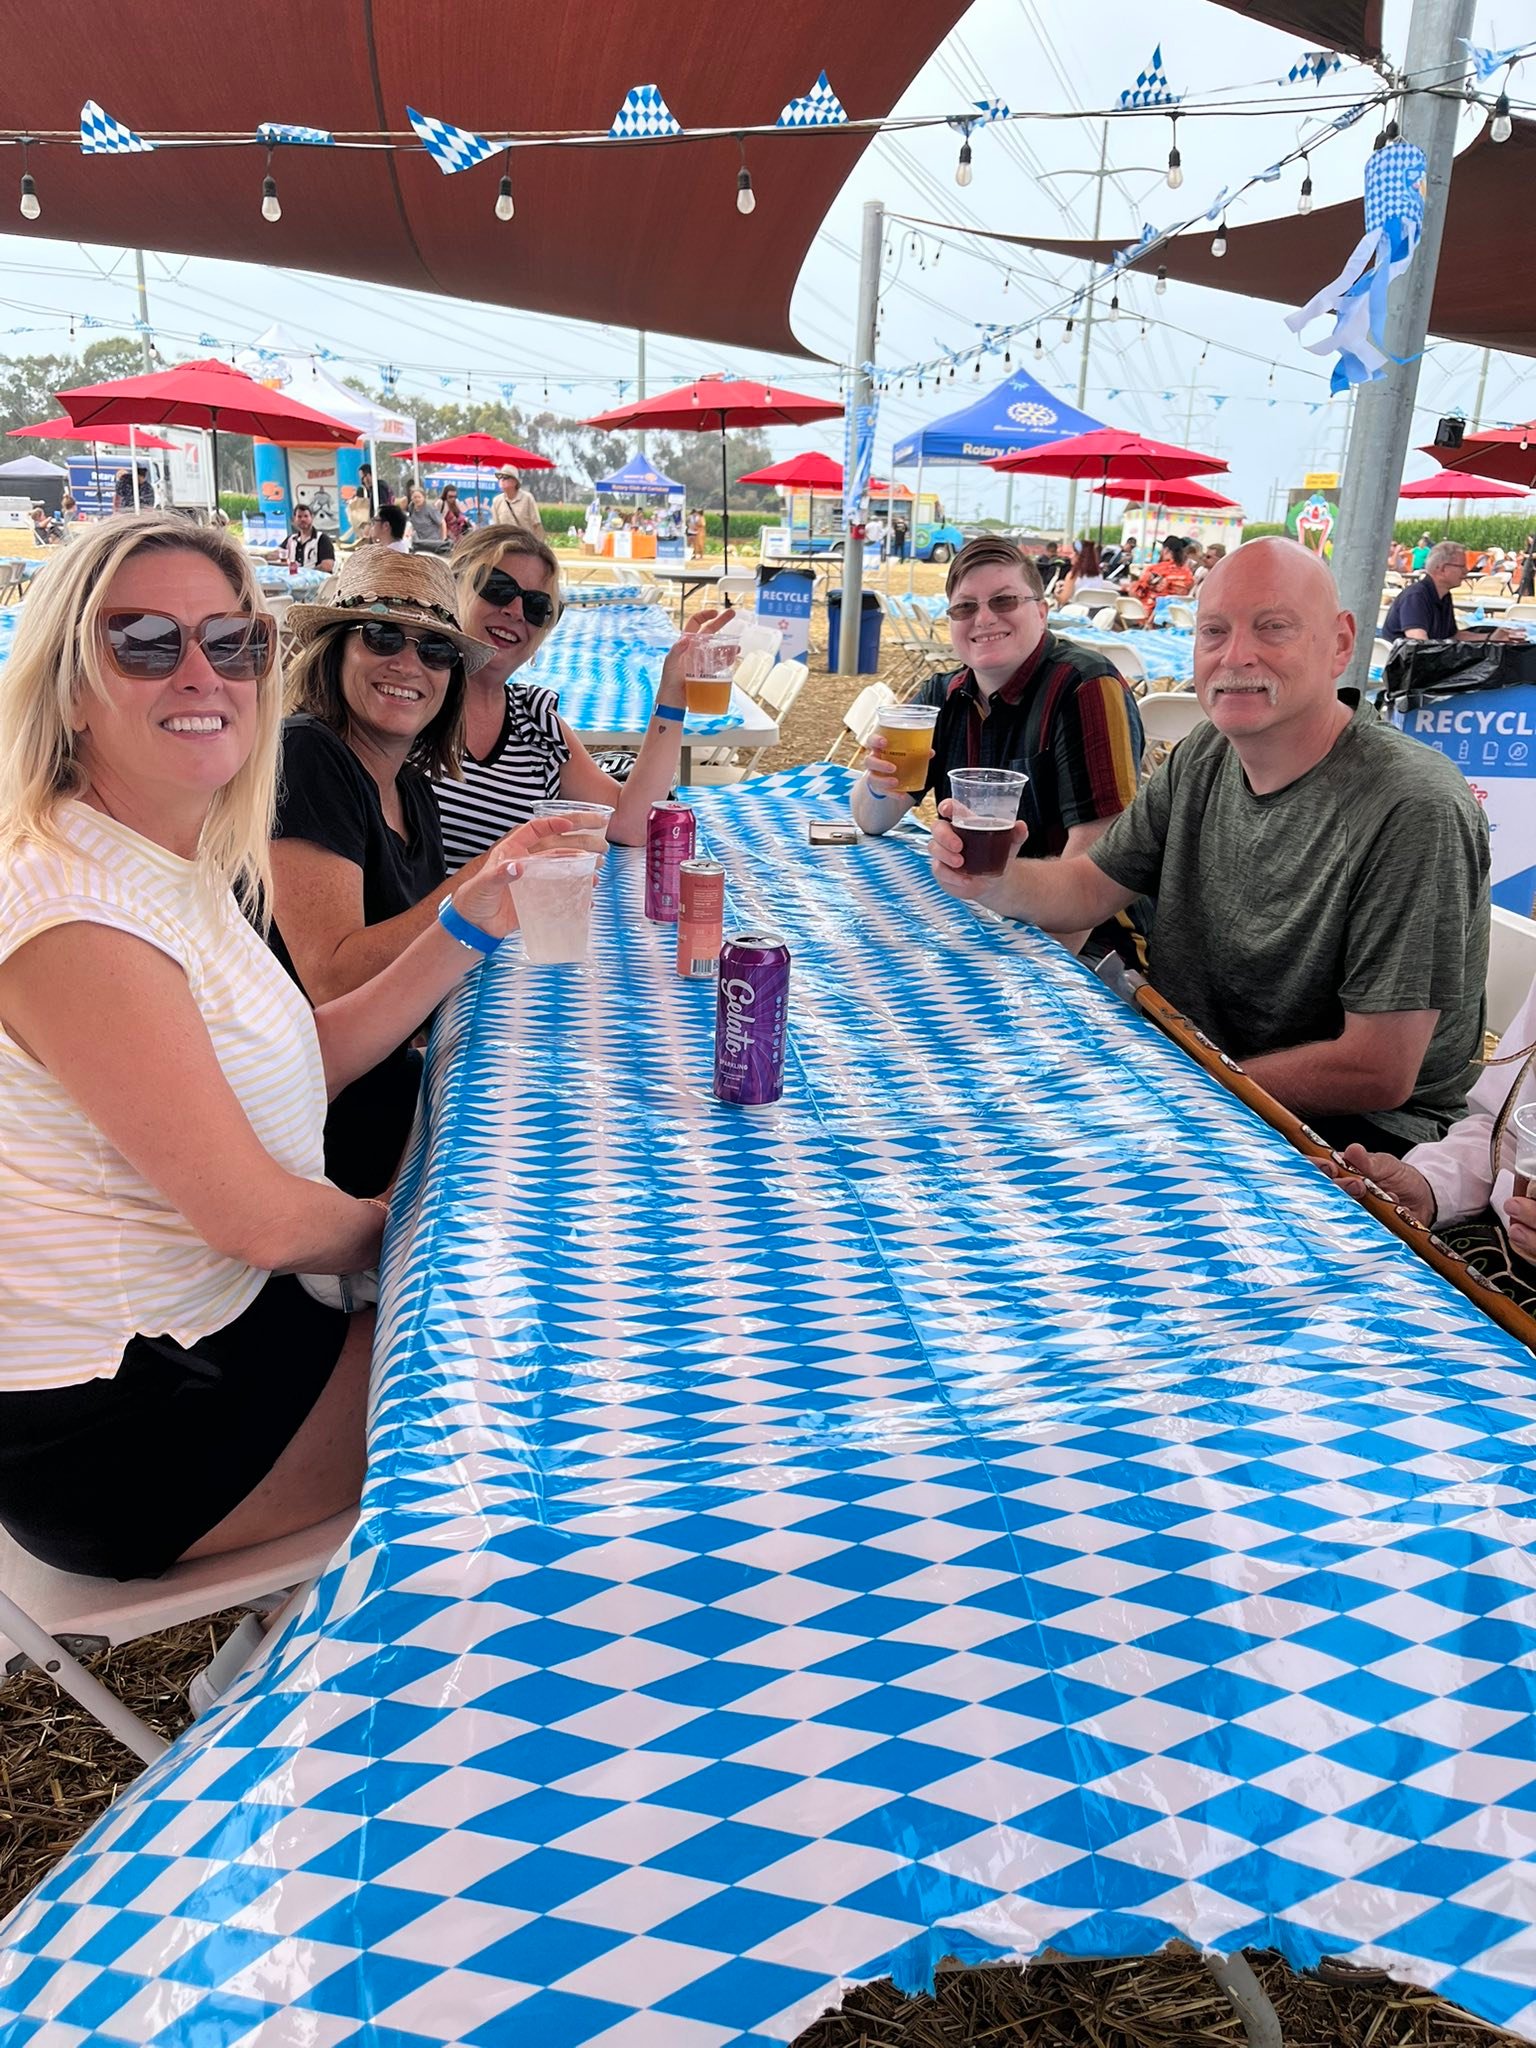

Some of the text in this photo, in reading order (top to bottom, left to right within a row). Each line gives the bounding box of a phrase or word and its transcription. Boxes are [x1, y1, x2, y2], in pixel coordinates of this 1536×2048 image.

[963, 443, 1004, 456] Rotary
[762, 590, 810, 603] RECYCLE
[1415, 709, 1536, 736] RECYCL
[720, 978, 756, 1058] Gelato
[719, 1058, 748, 1070] SPARKLING
